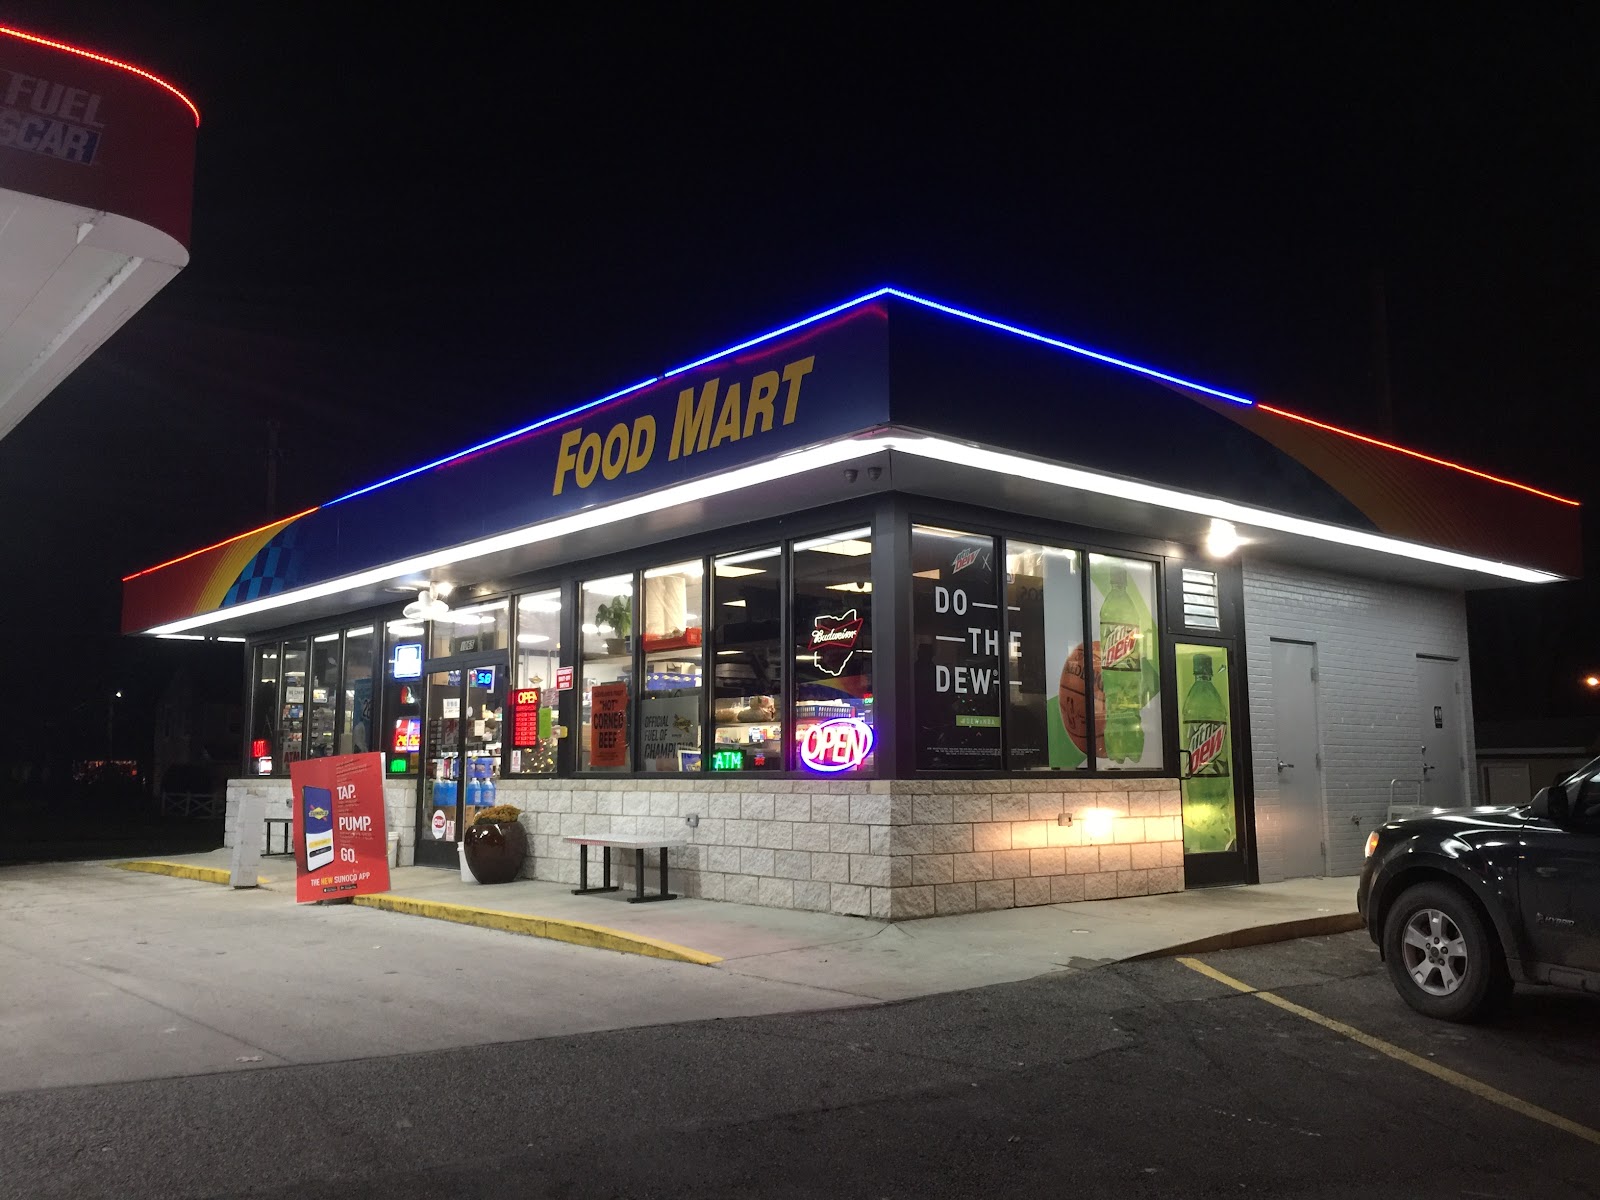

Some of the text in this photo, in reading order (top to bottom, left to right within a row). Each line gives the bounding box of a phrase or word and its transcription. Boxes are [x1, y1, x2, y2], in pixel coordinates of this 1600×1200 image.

[4, 73, 104, 128] FUEL
[552, 355, 816, 496] FOOD MART
[935, 586, 968, 616] DO
[967, 627, 1023, 658] THE
[598, 731, 617, 749] BEEF
[660, 729, 668, 741] OF
[806, 724, 867, 766] OPEN
[714, 751, 741, 770] ATM
[337, 784, 357, 800] TAP.
[339, 815, 373, 832] PUMP.
[340, 847, 358, 864] GO.
[311, 871, 371, 887] THE NEW SUNOCO APP
